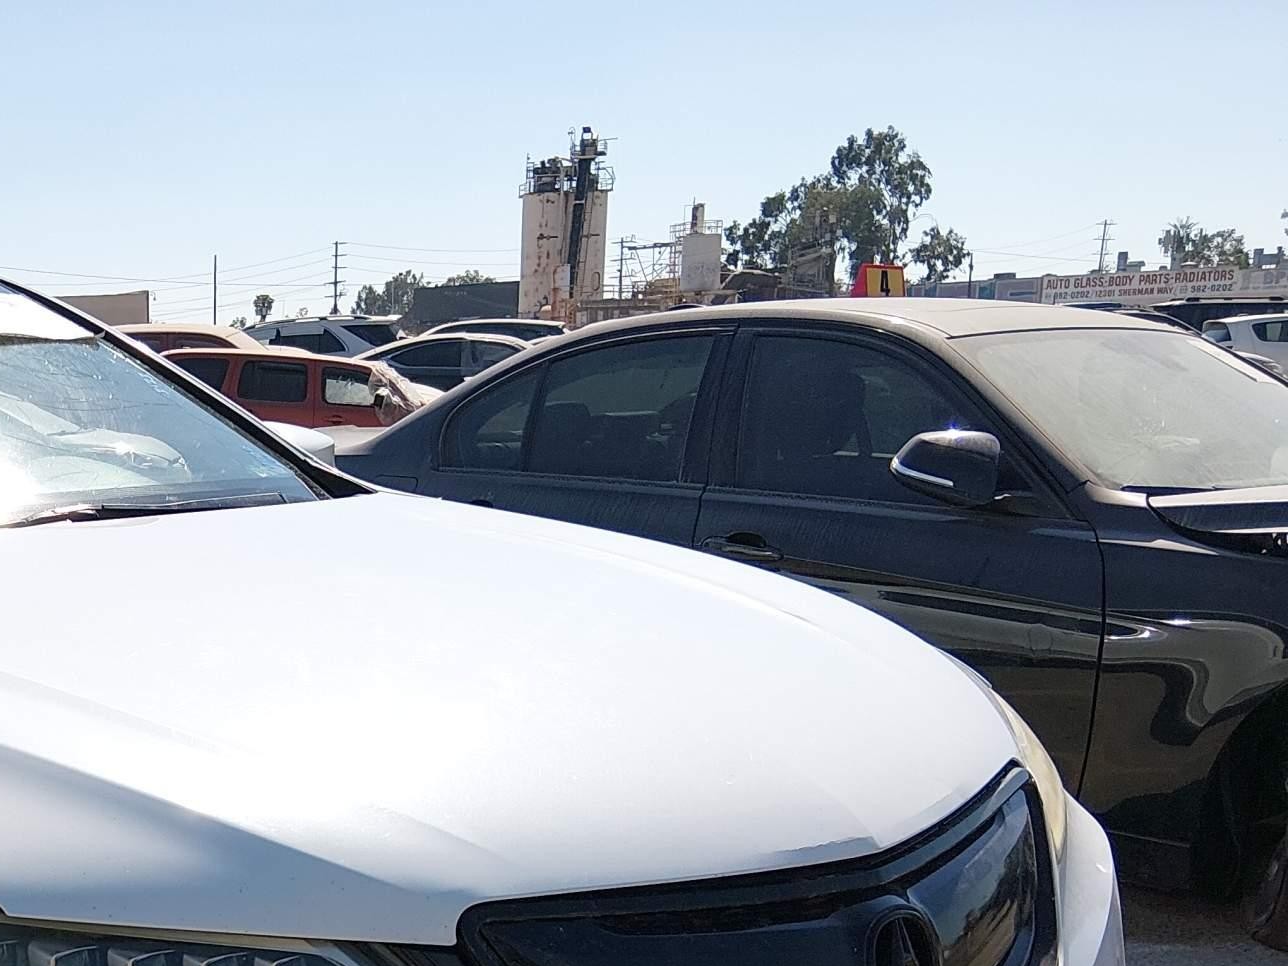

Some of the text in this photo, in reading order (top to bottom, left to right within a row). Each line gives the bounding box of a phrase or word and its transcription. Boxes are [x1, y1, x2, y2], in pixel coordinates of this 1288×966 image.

[880, 270, 891, 297] 4
[1046, 278, 1070, 290] AUTO
[1117, 287, 1155, 297] SHERMAN
[1156, 286, 1174, 296] WAY
